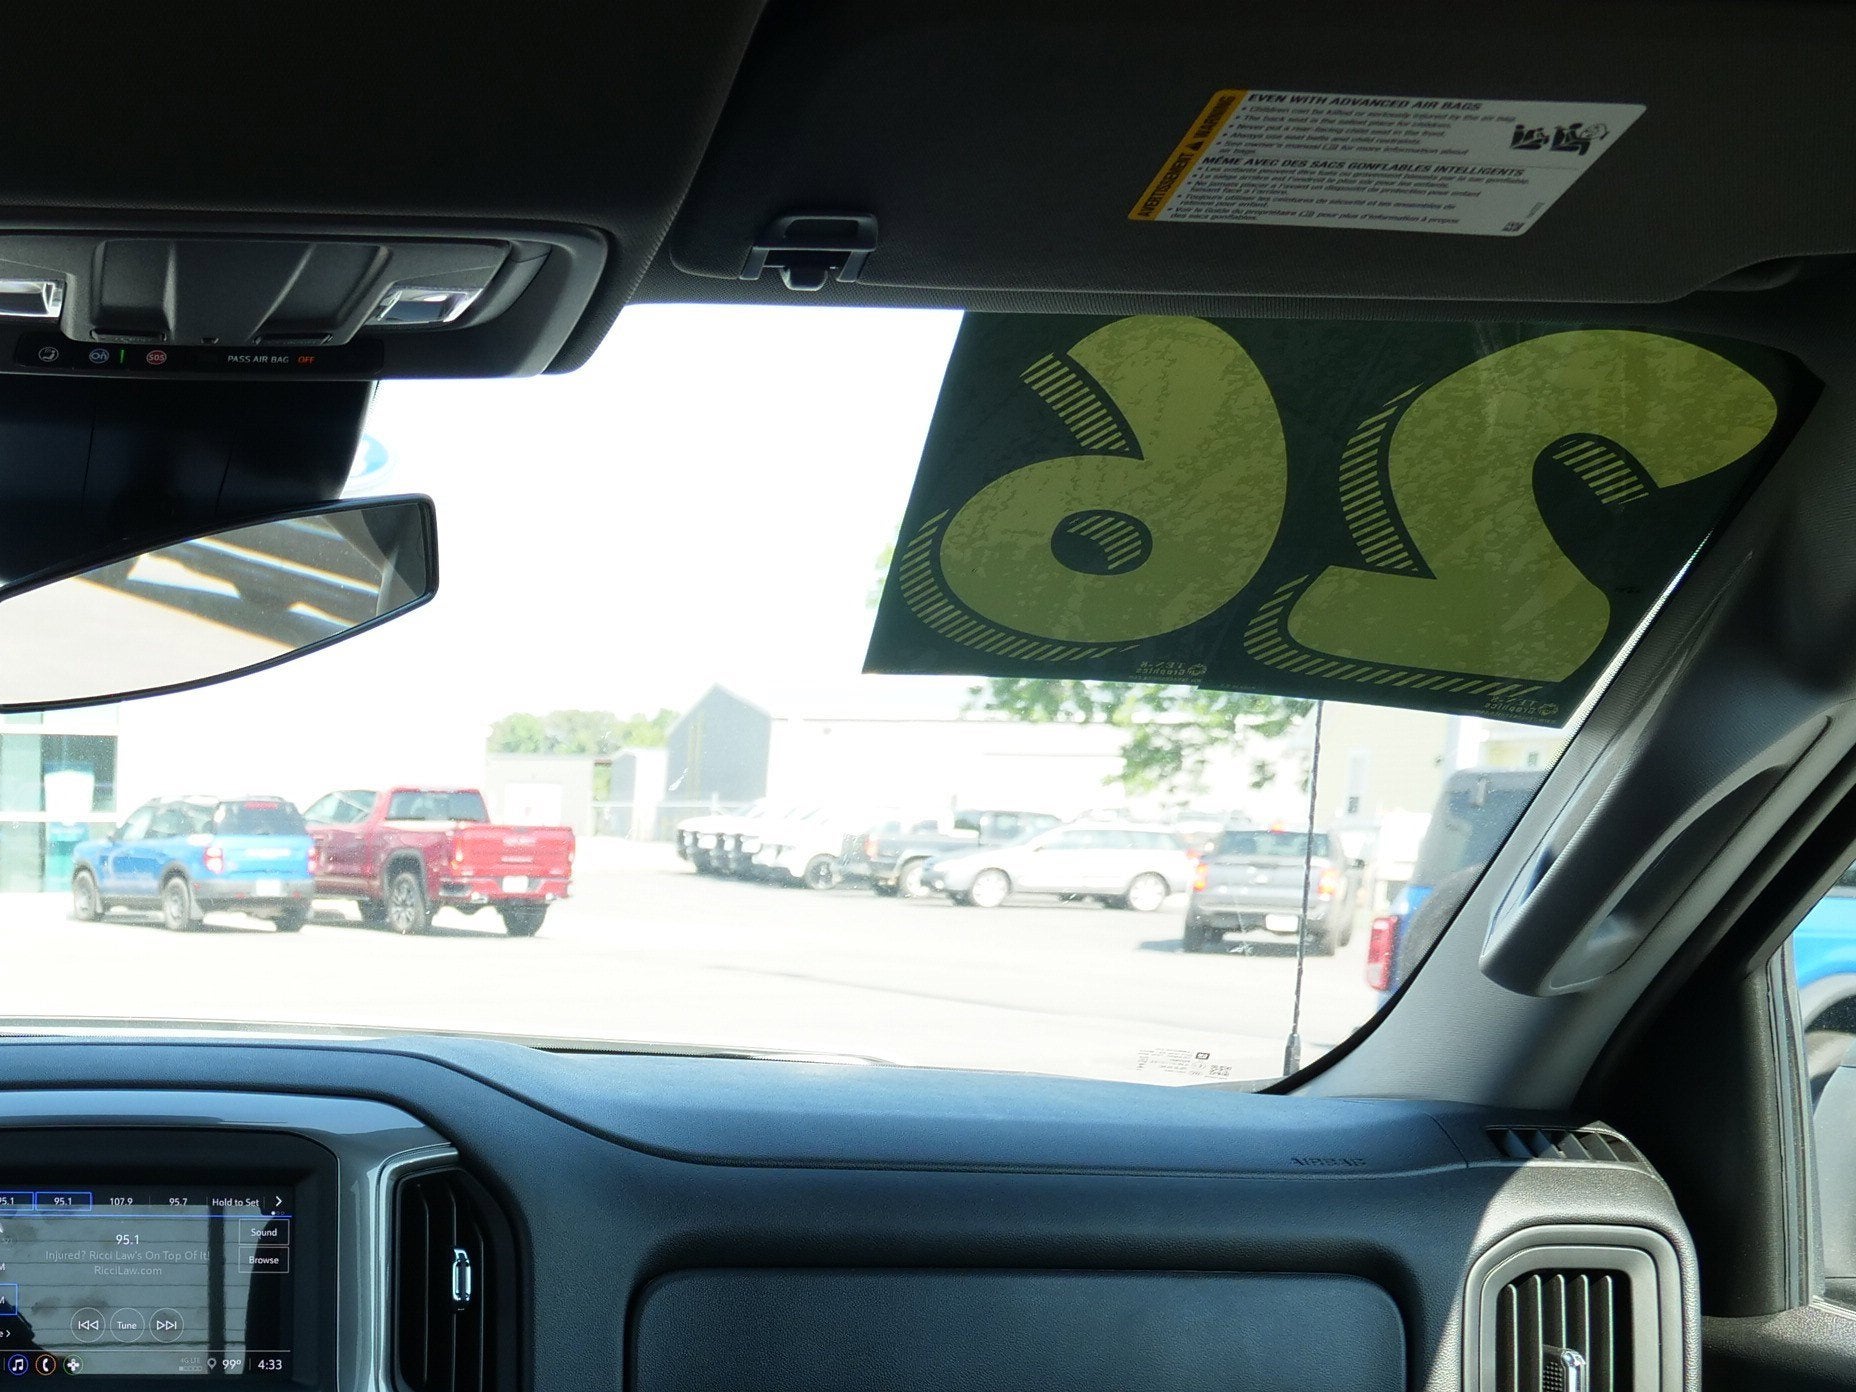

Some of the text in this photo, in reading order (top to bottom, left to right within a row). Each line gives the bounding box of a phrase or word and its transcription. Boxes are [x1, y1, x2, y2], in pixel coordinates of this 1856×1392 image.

[1248, 94, 1483, 111] EVEN WITH ADVANCED AIR BAGS
[1244, 158, 1279, 166] AVEC
[1282, 159, 1307, 168] DES
[1310, 160, 1346, 169] SACS
[1348, 161, 1431, 171] GONFLABLES
[1434, 164, 1526, 175] INTELLIGENTS
[148, 353, 165, 362] SOS
[228, 355, 315, 364] PASS AIR BAG OFF
[54, 1196, 73, 1206] 95.1
[110, 1197, 134, 1206] 107.9
[169, 1197, 188, 1206] 95.7
[212, 1197, 260, 1207] Hold to Set
[251, 1228, 278, 1238] Sound
[116, 1233, 140, 1246] 95.1
[45, 1250, 210, 1262] Injured? Ricci Law's On Top Of It!
[248, 1255, 279, 1265] Browse
[94, 1265, 162, 1275] RicciLaw.com
[117, 1321, 137, 1330] Tune
[222, 1358, 241, 1370] 99°
[258, 1359, 282, 1371] 4:33
